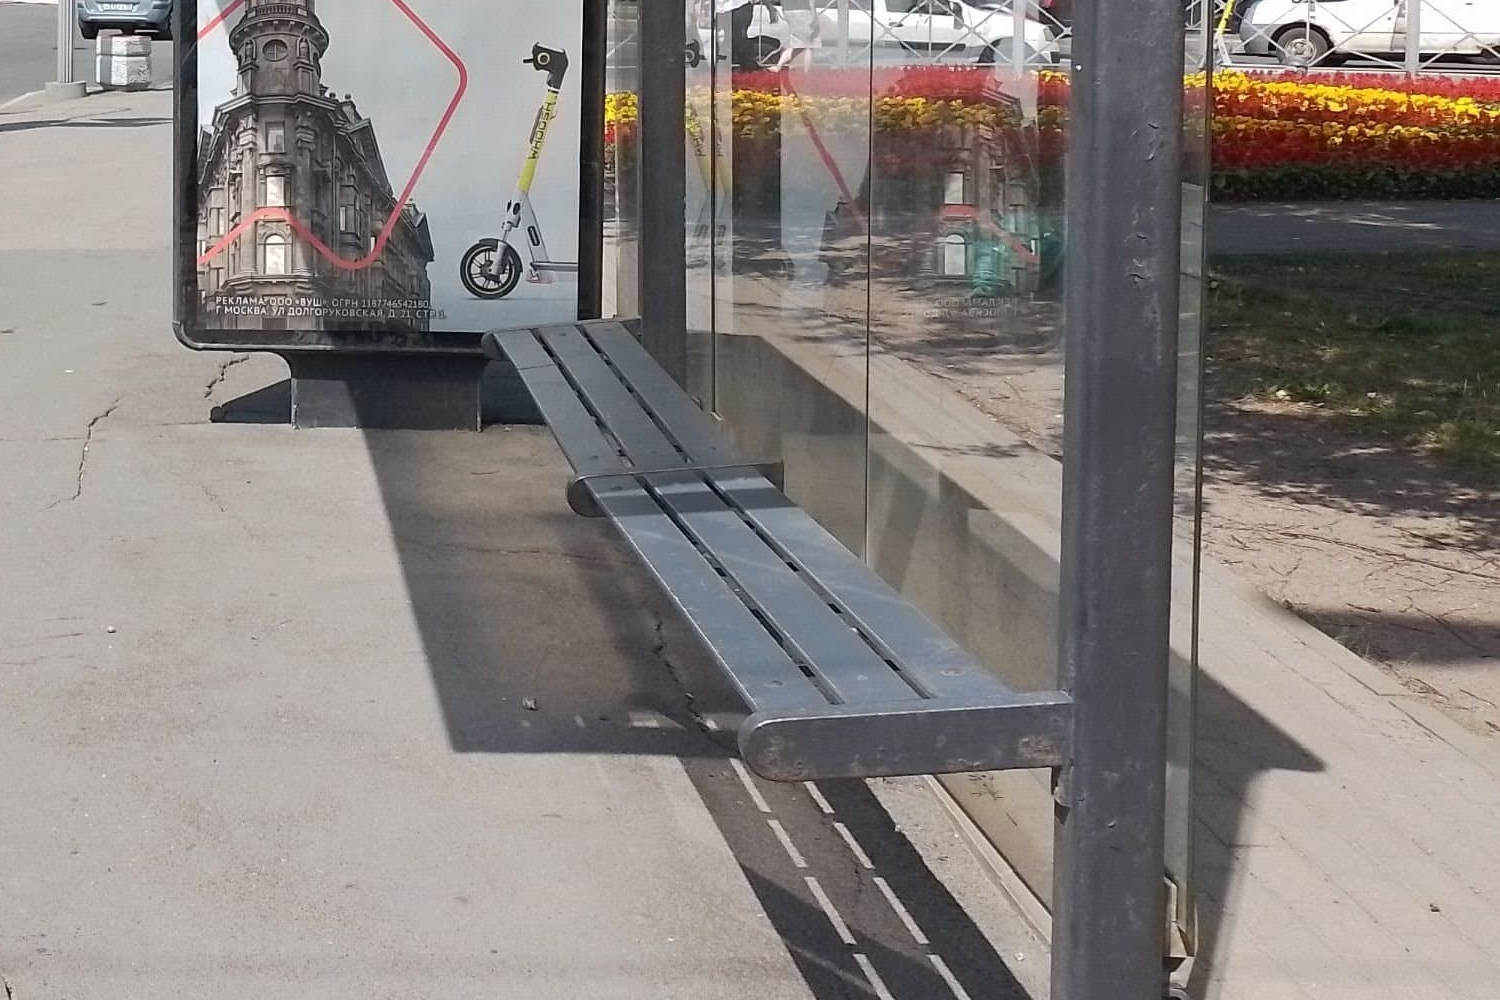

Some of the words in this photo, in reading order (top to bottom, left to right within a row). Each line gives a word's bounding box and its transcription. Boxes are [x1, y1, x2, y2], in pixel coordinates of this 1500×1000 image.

[528, 102, 553, 159] WHOOSH
[269, 297, 293, 307] ООО
[331, 298, 359, 309] ОГРН
[287, 307, 383, 318] ДОЛГОРУКОВСКАЯ
